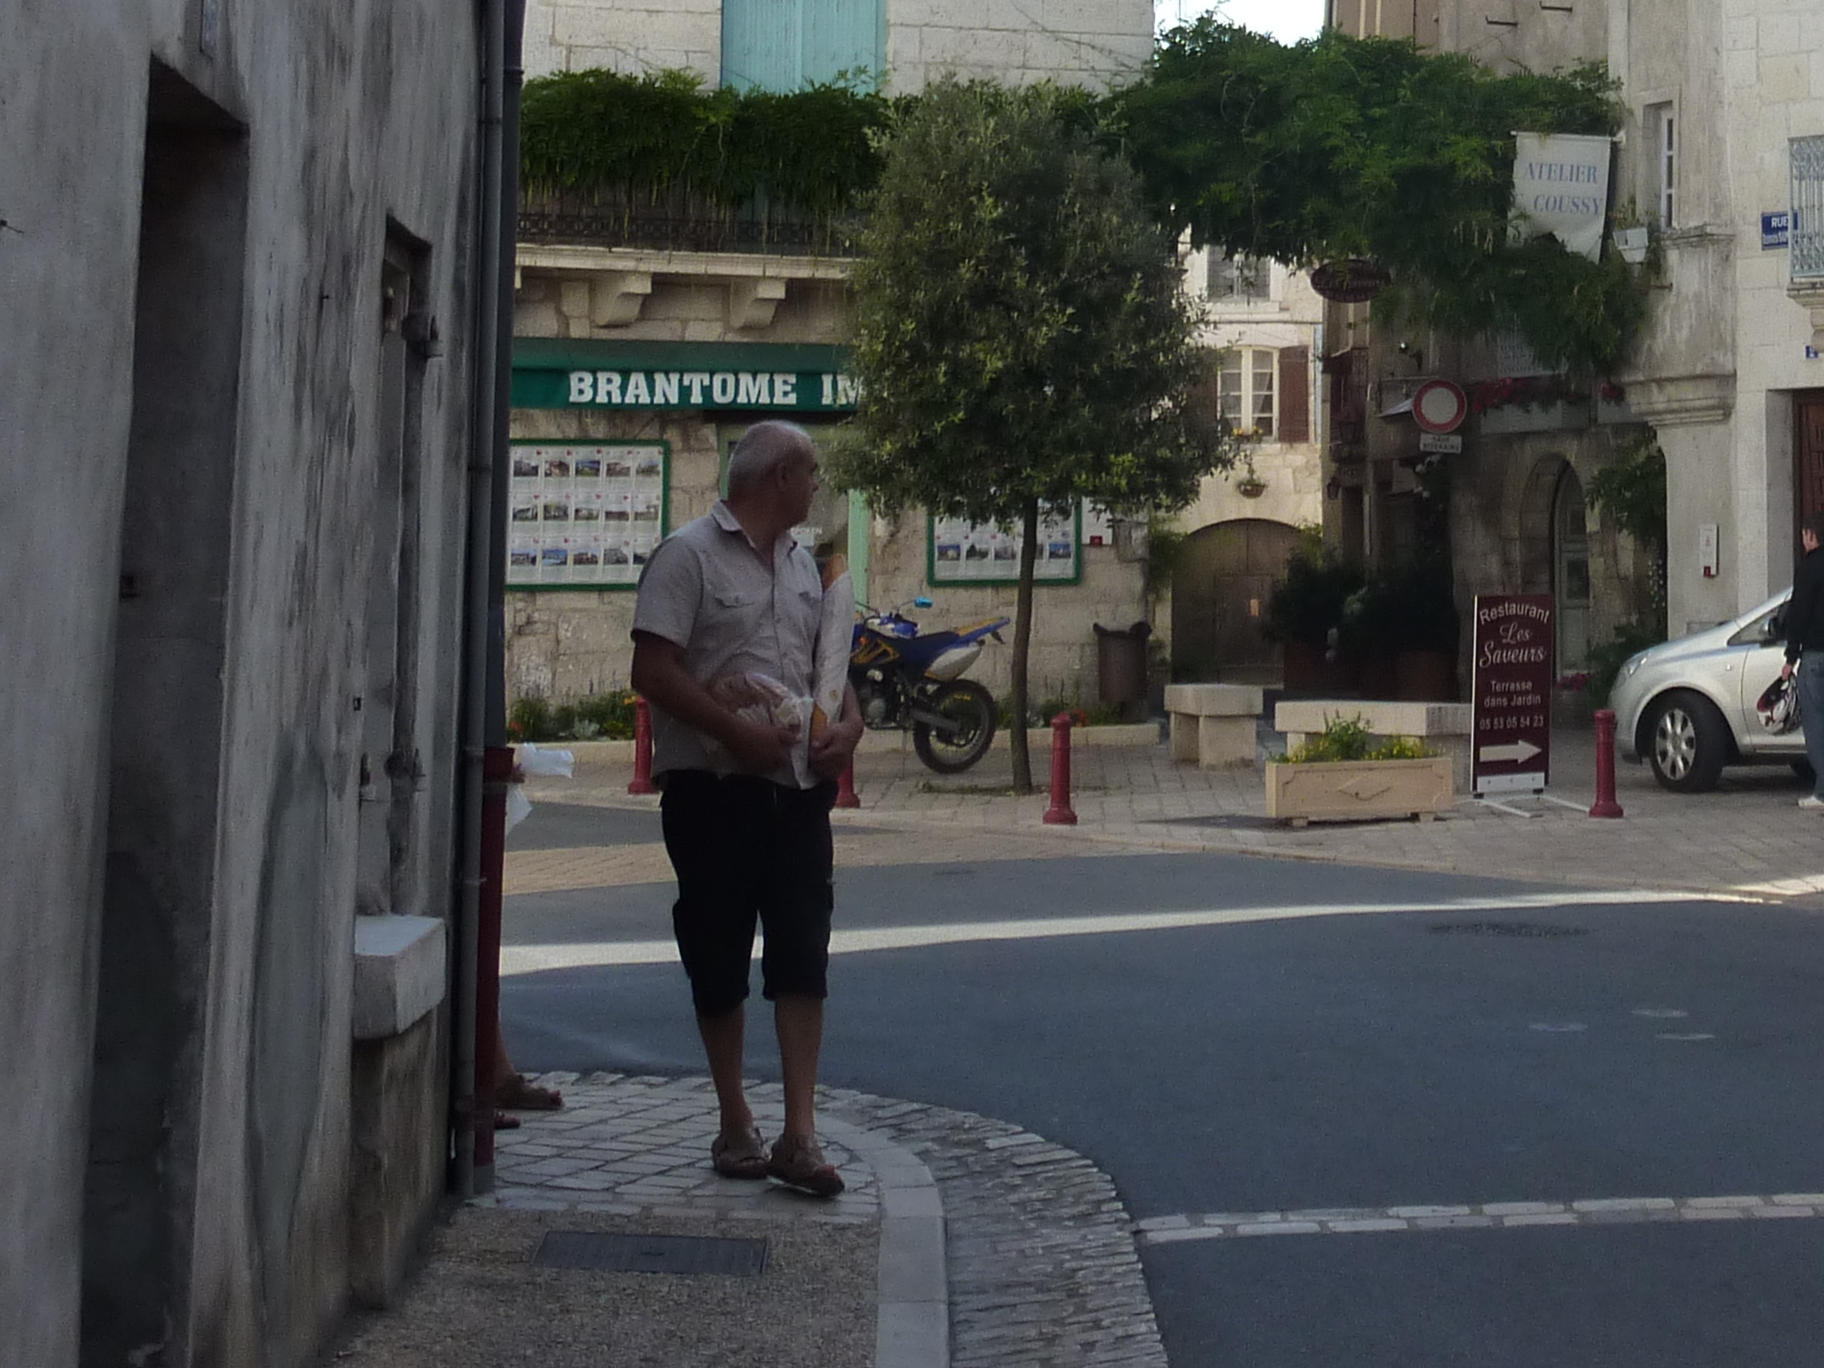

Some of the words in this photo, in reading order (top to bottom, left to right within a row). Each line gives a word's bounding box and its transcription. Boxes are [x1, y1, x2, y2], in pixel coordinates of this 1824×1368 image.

[1523, 162, 1598, 184] ATELIER
[1771, 216, 1789, 229] RUE
[569, 371, 797, 405] BRANTOME
[1480, 602, 1549, 625] Restaurant
[1500, 622, 1532, 644] Les
[1479, 640, 1547, 668] Saveurs
[1490, 680, 1533, 692] Terrasse
[1484, 695, 1508, 708] dans
[1510, 693, 1542, 707] Jardin
